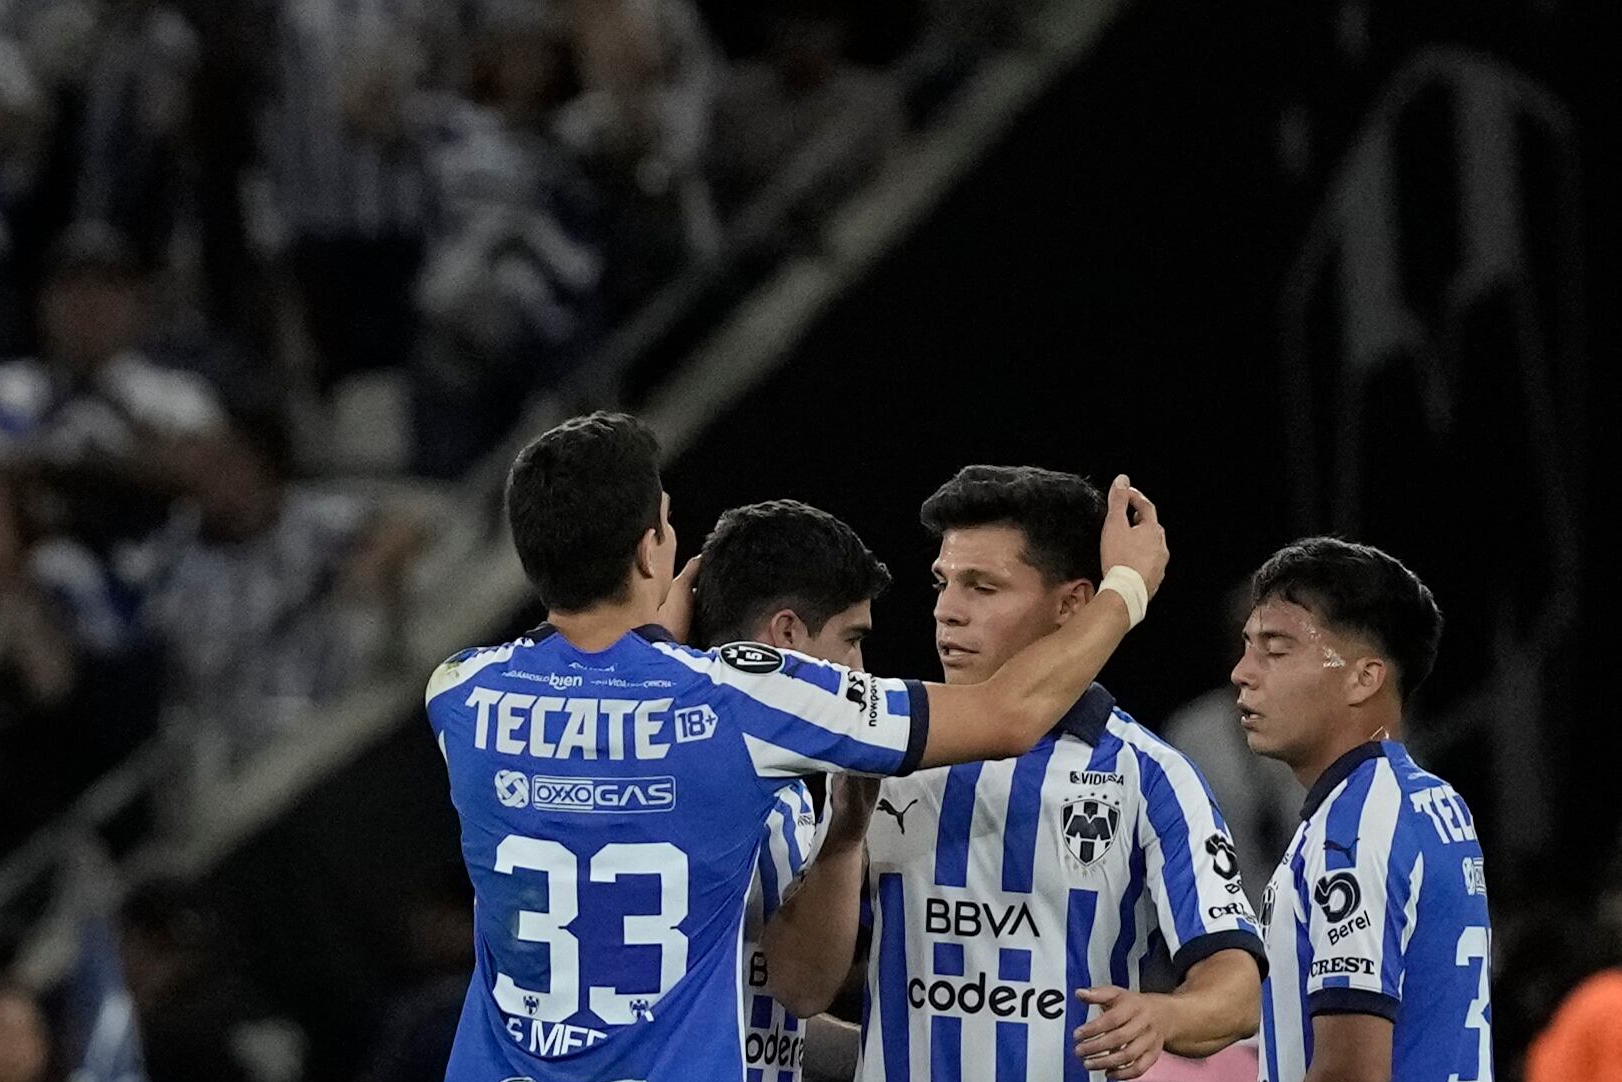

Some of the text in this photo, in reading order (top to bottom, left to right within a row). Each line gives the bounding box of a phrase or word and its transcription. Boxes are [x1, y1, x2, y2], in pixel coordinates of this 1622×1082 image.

[549, 673, 582, 689] bien
[465, 686, 716, 760] TECATE 18+
[1409, 785, 1478, 844] TEC
[492, 835, 688, 1025] 33
[926, 898, 1040, 938] BBVA
[1328, 910, 1371, 946] Berel
[1310, 957, 1375, 978] CREST
[909, 973, 1065, 1020] codere
